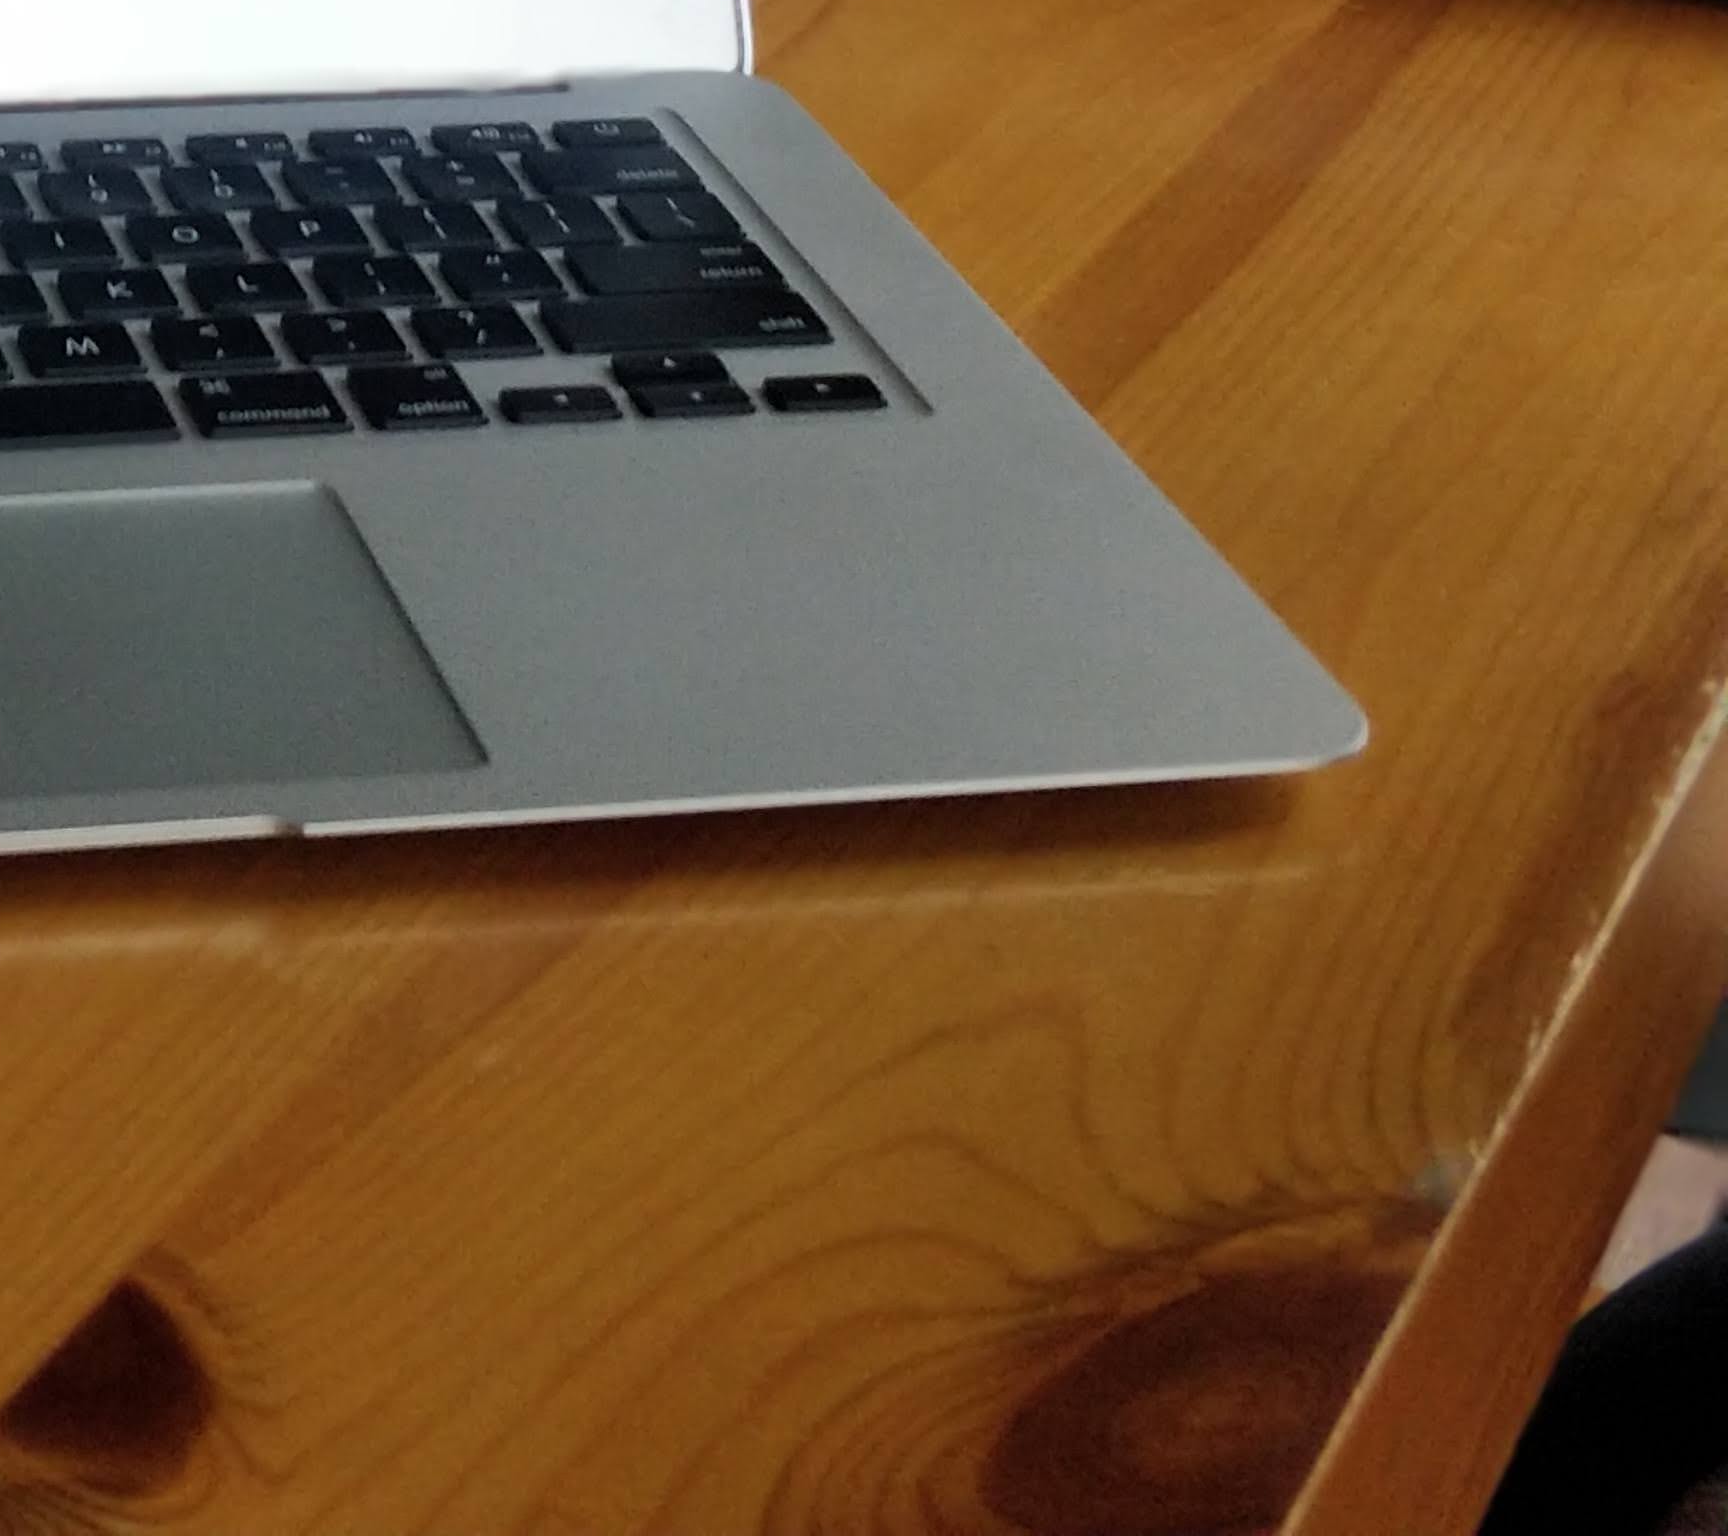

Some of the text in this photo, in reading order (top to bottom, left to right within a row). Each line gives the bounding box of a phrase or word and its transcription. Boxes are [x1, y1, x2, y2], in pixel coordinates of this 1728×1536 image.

[106, 279, 134, 300] K
[236, 274, 260, 294] L
[65, 336, 101, 357] M
[217, 400, 469, 424] command option
